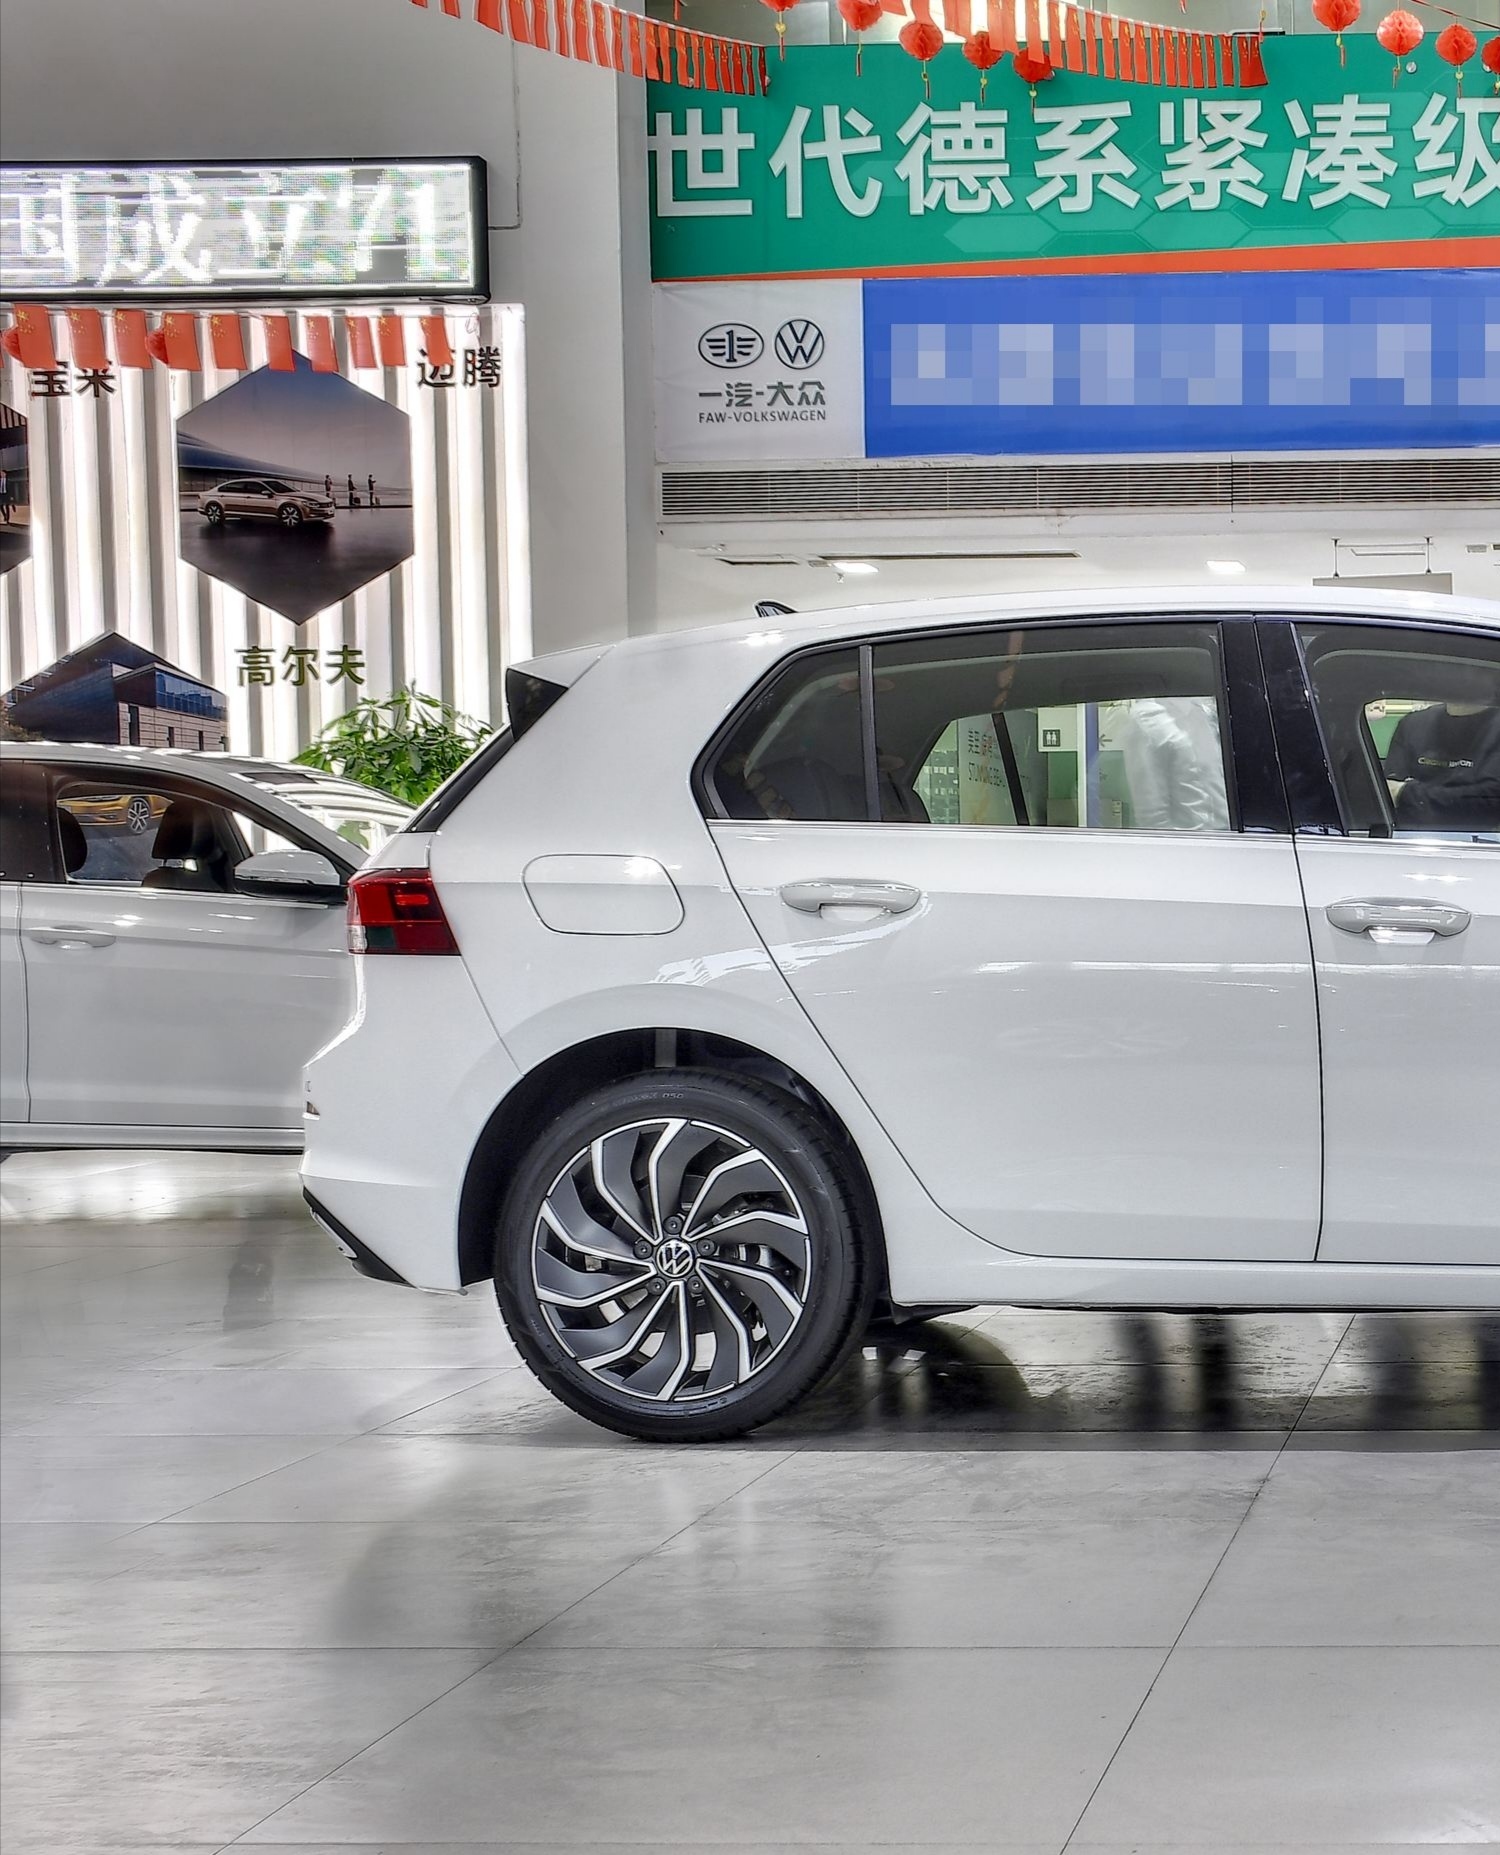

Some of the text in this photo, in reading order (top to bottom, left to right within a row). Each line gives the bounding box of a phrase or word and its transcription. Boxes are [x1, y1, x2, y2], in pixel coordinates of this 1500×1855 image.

[698, 380, 826, 408] 一汽-大众
[698, 409, 827, 424] FAW-VOLKSWAGEN
[233, 644, 366, 687] 高尔夫
